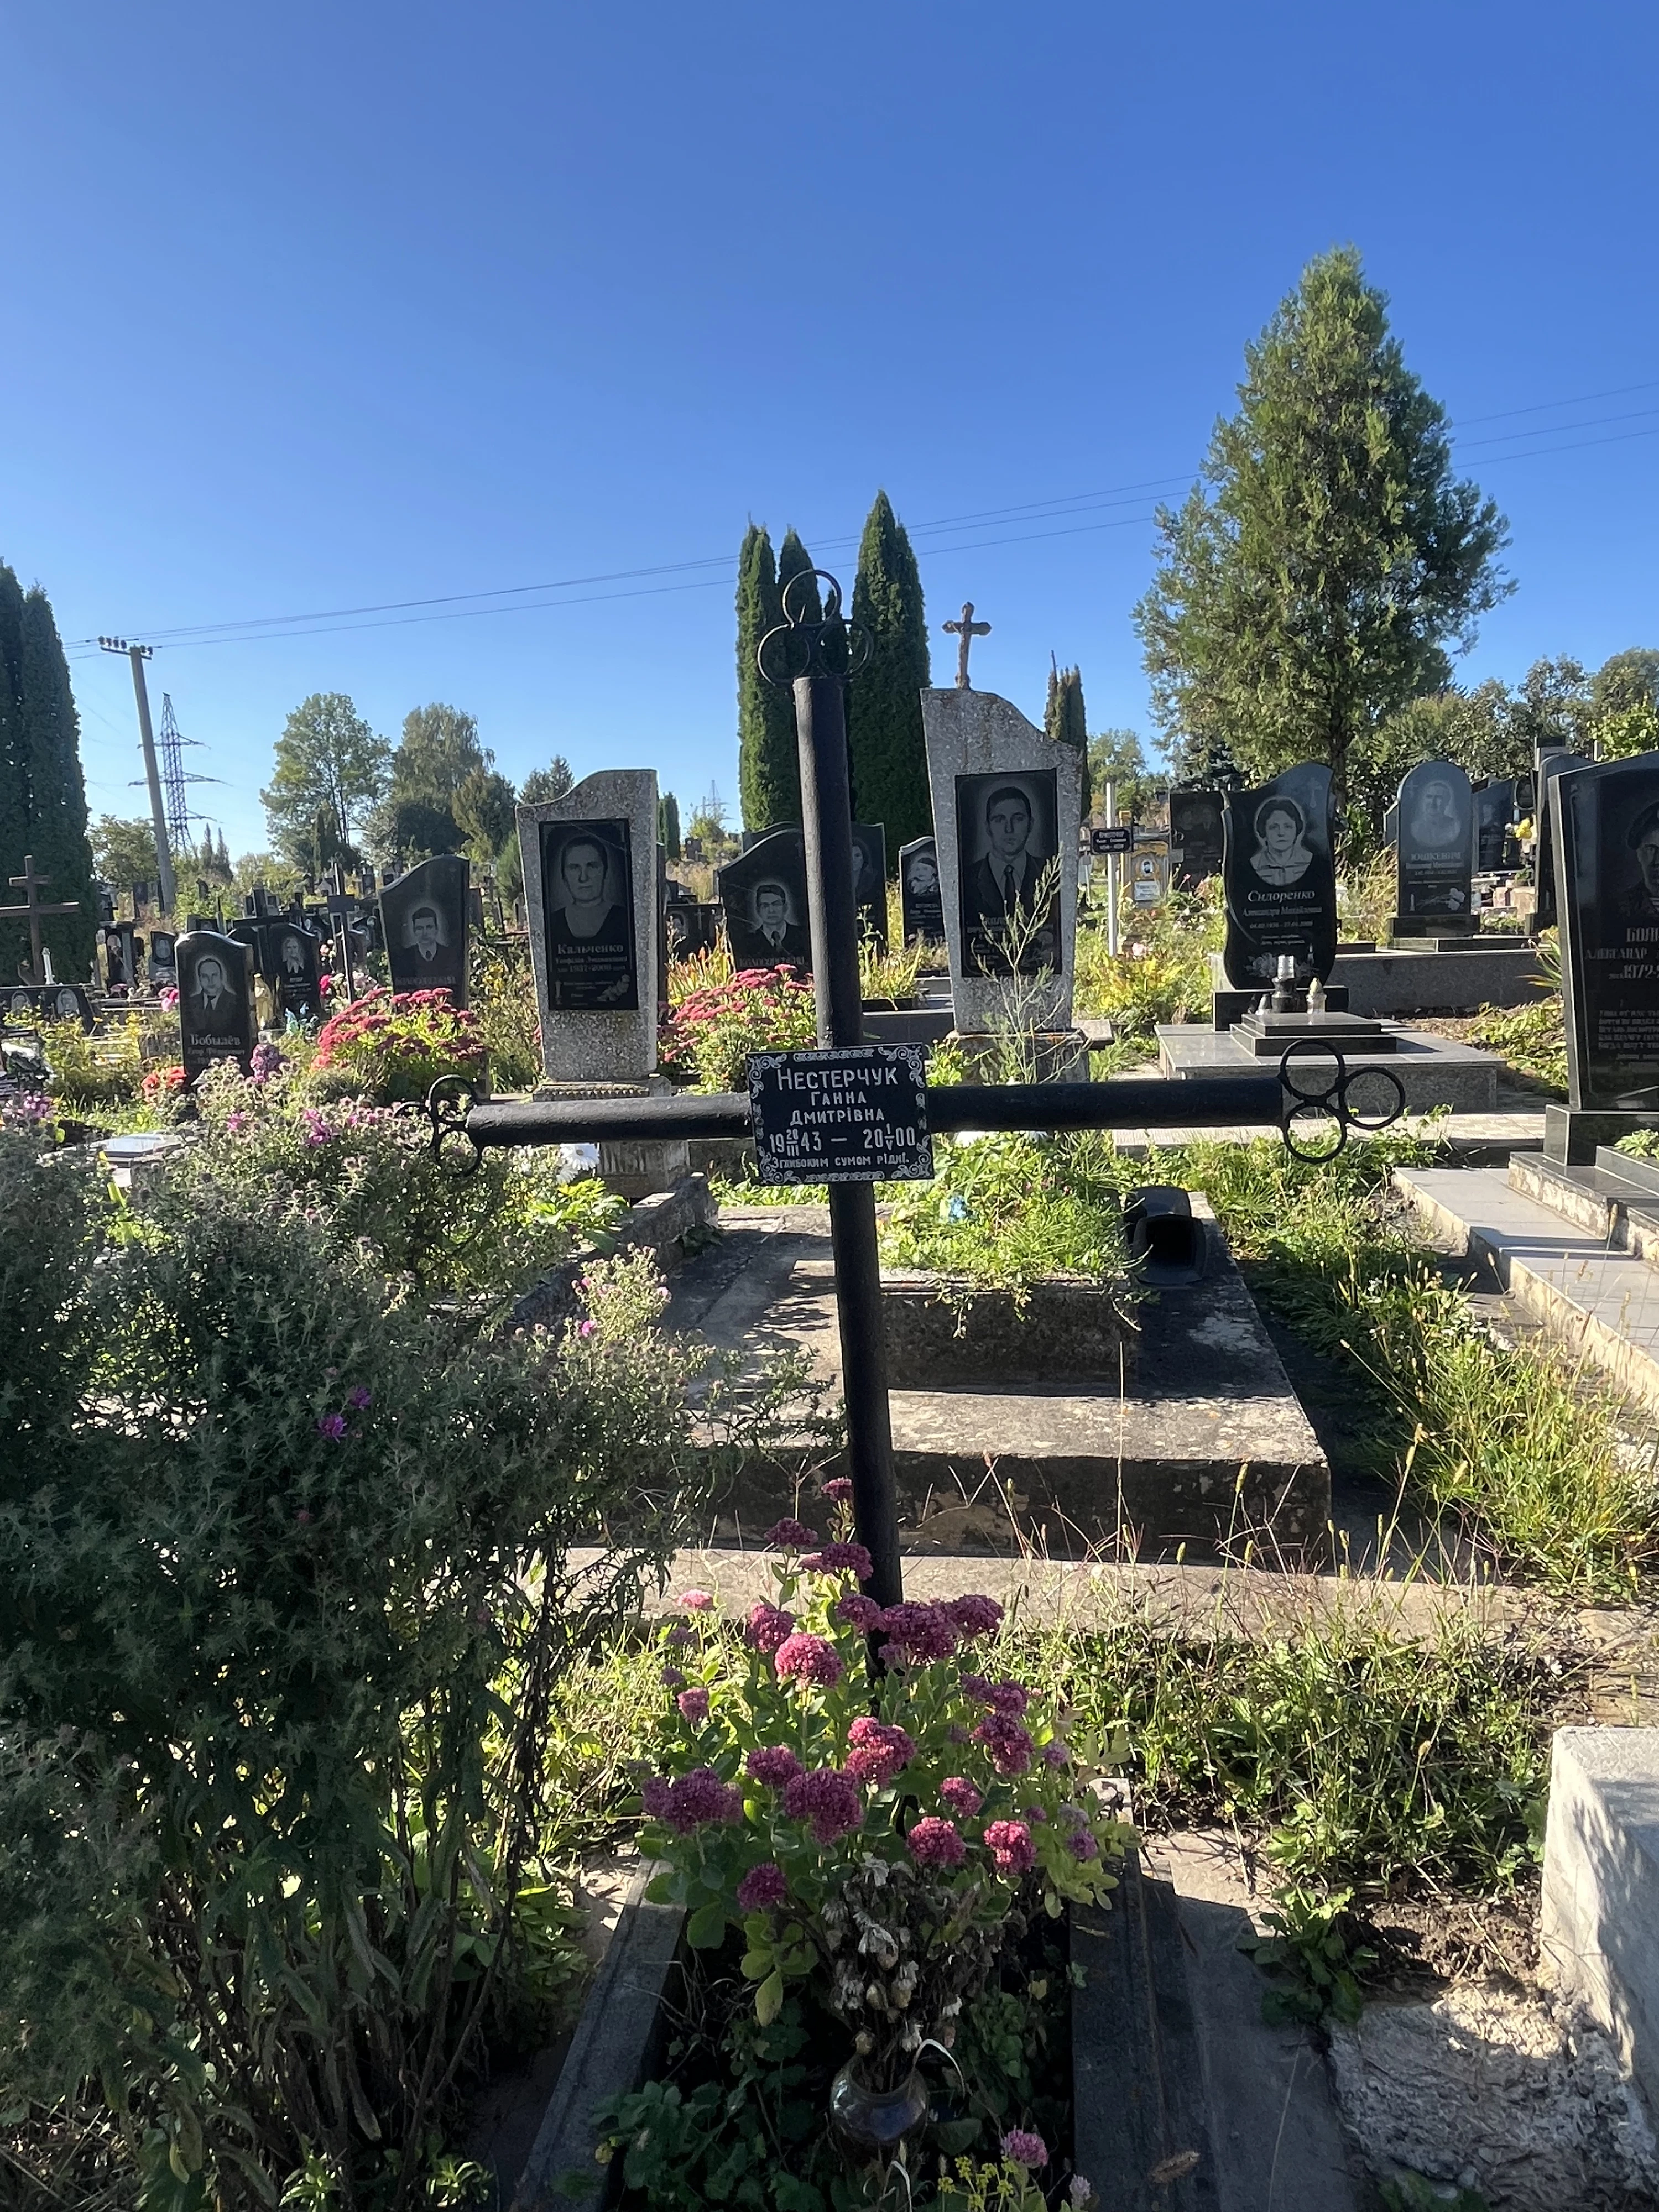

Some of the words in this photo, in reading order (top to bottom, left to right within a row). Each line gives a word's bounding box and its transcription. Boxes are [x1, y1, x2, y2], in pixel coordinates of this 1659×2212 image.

[1248, 890, 1316, 903] Сидоренко
[557, 943, 623, 954] Кальченко
[811, 1091, 867, 1106] ГАННА
[790, 1107, 885, 1126] ДМИТРІВНА
